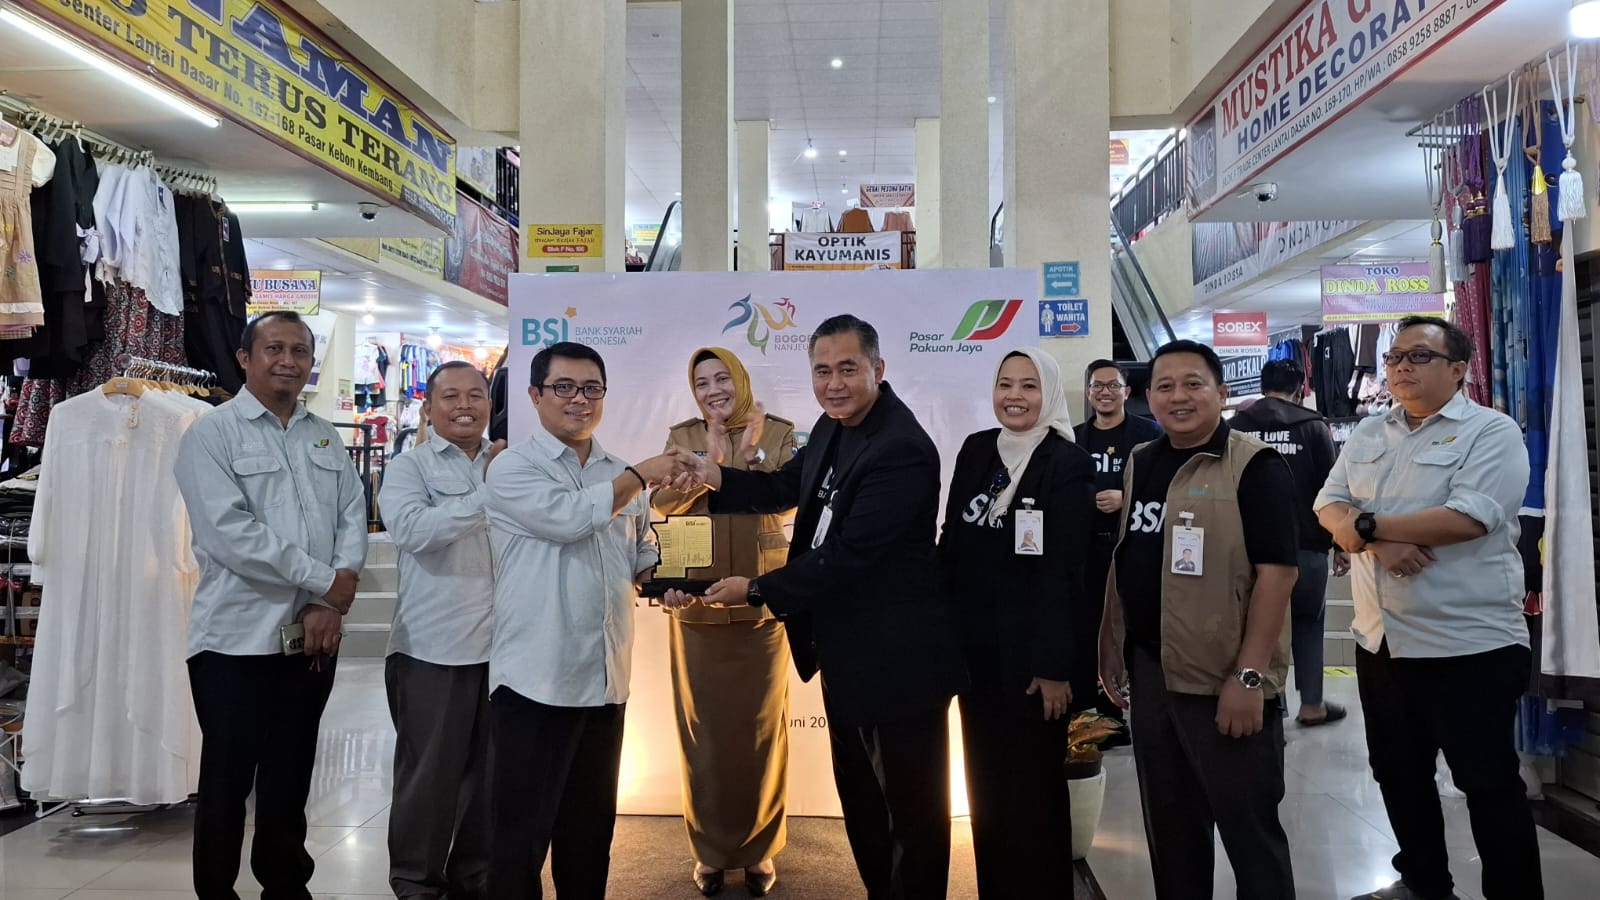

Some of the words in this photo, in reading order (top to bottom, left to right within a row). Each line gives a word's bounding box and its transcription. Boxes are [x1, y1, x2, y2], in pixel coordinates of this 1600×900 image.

[1221, 0, 1337, 139] MUSTIKA
[1251, 145, 1271, 166] CENTER
[1271, 131, 1290, 152] LANTAI
[1290, 115, 1311, 138] DASAR
[1354, 61, 1381, 92] HP/WA
[1387, 41, 1408, 67] 0858
[1409, 23, 1432, 51] 9258
[1433, 3, 1457, 33] 8887
[126, 23, 175, 68] Lantai
[180, 56, 219, 92] Dasar
[223, 81, 243, 107] No.
[249, 95, 295, 137] 167-168
[299, 125, 325, 152] Pasar
[329, 142, 355, 169] Kebon
[358, 159, 393, 191] Kembang
[168, 5, 327, 129] TERUS
[338, 114, 451, 203] TERANG
[1237, 91, 1291, 154] HOME
[537, 227, 570, 237] SinJaya
[572, 227, 594, 238] Fajar
[818, 236, 866, 247] OPTIK
[795, 248, 891, 261] KAYUMANIS
[1049, 265, 1074, 273] APOTIK
[1365, 266, 1400, 275] TOKO
[265, 279, 317, 290] BUSANA
[1204, 277, 1223, 294] DINDA
[1324, 278, 1381, 294] DINDA
[1385, 276, 1430, 293] ROSS
[1057, 303, 1083, 311] TOILET
[1056, 313, 1086, 321] WANITA
[522, 318, 569, 346] BSI
[575, 326, 602, 336] BANK
[603, 326, 643, 336] SYARIAH
[1217, 321, 1262, 333] SOREX
[575, 336, 628, 346] INDONESIA
[909, 331, 945, 342] Pasar
[909, 343, 954, 353] Pakuan
[955, 343, 984, 355] Jaya
[1222, 362, 1236, 381] OKO
[1264, 430, 1290, 442] LOVE
[1130, 500, 1167, 533] BSI
